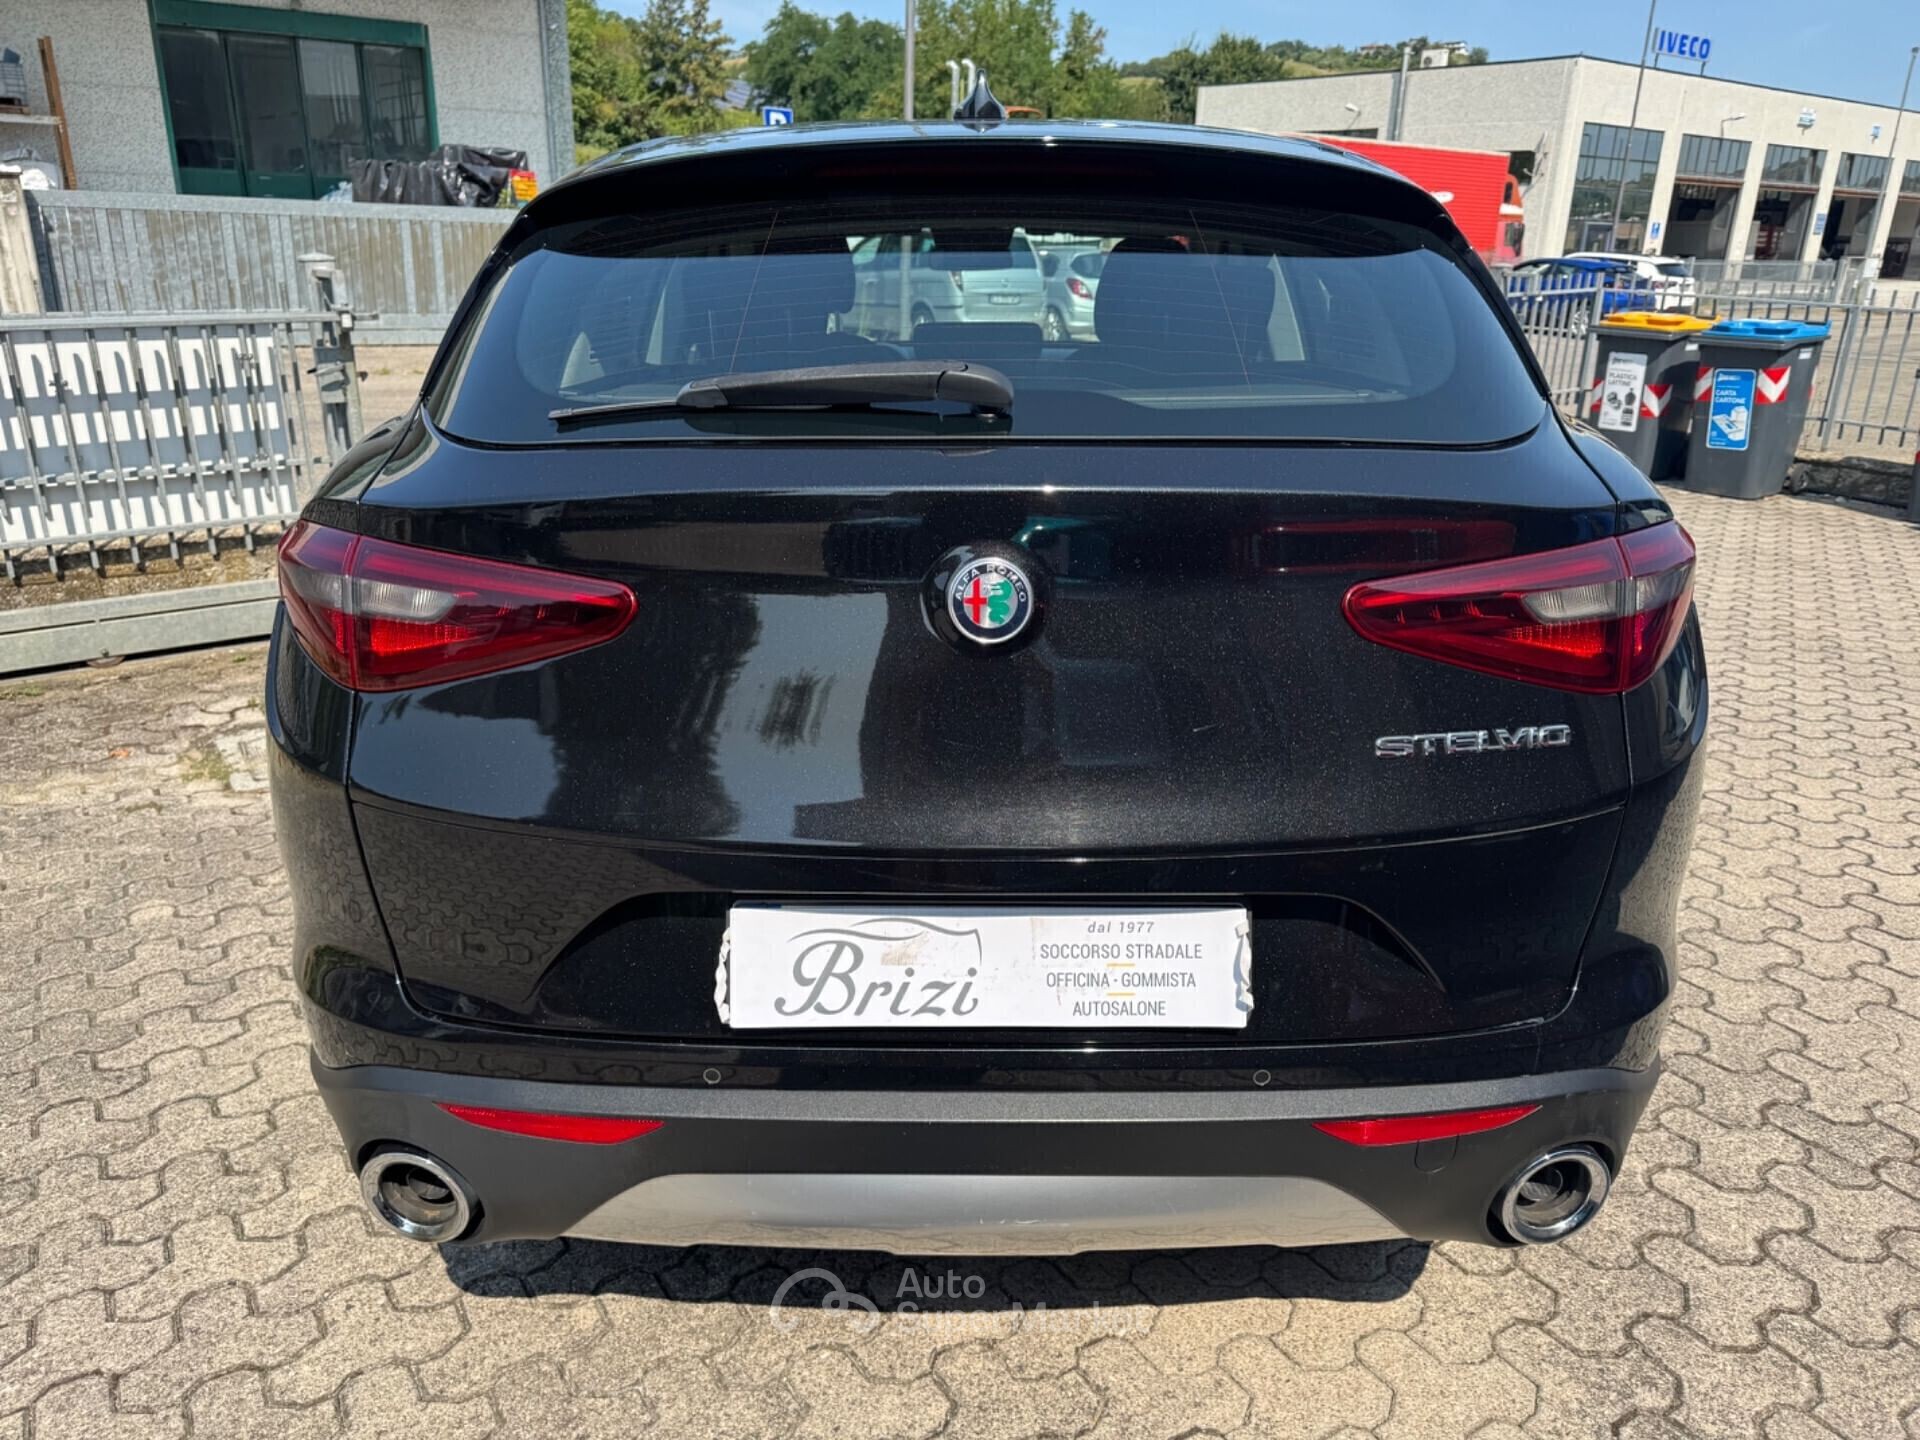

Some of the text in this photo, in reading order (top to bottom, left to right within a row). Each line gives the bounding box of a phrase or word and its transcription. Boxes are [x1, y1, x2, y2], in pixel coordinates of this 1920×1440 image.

[1658, 30, 1711, 60] IVECO
[955, 564, 1027, 602] ALFA ROMEO
[1376, 724, 1571, 757] STELVIO
[1087, 921, 1155, 934] dal 1977
[1040, 943, 1203, 960] SOCCORSO STRADALE
[774, 940, 979, 1017] Brizi
[1046, 972, 1110, 988] OFFICINA
[1121, 972, 1196, 988] GOMMISTA
[1072, 1000, 1167, 1017] AUTOSALONE
